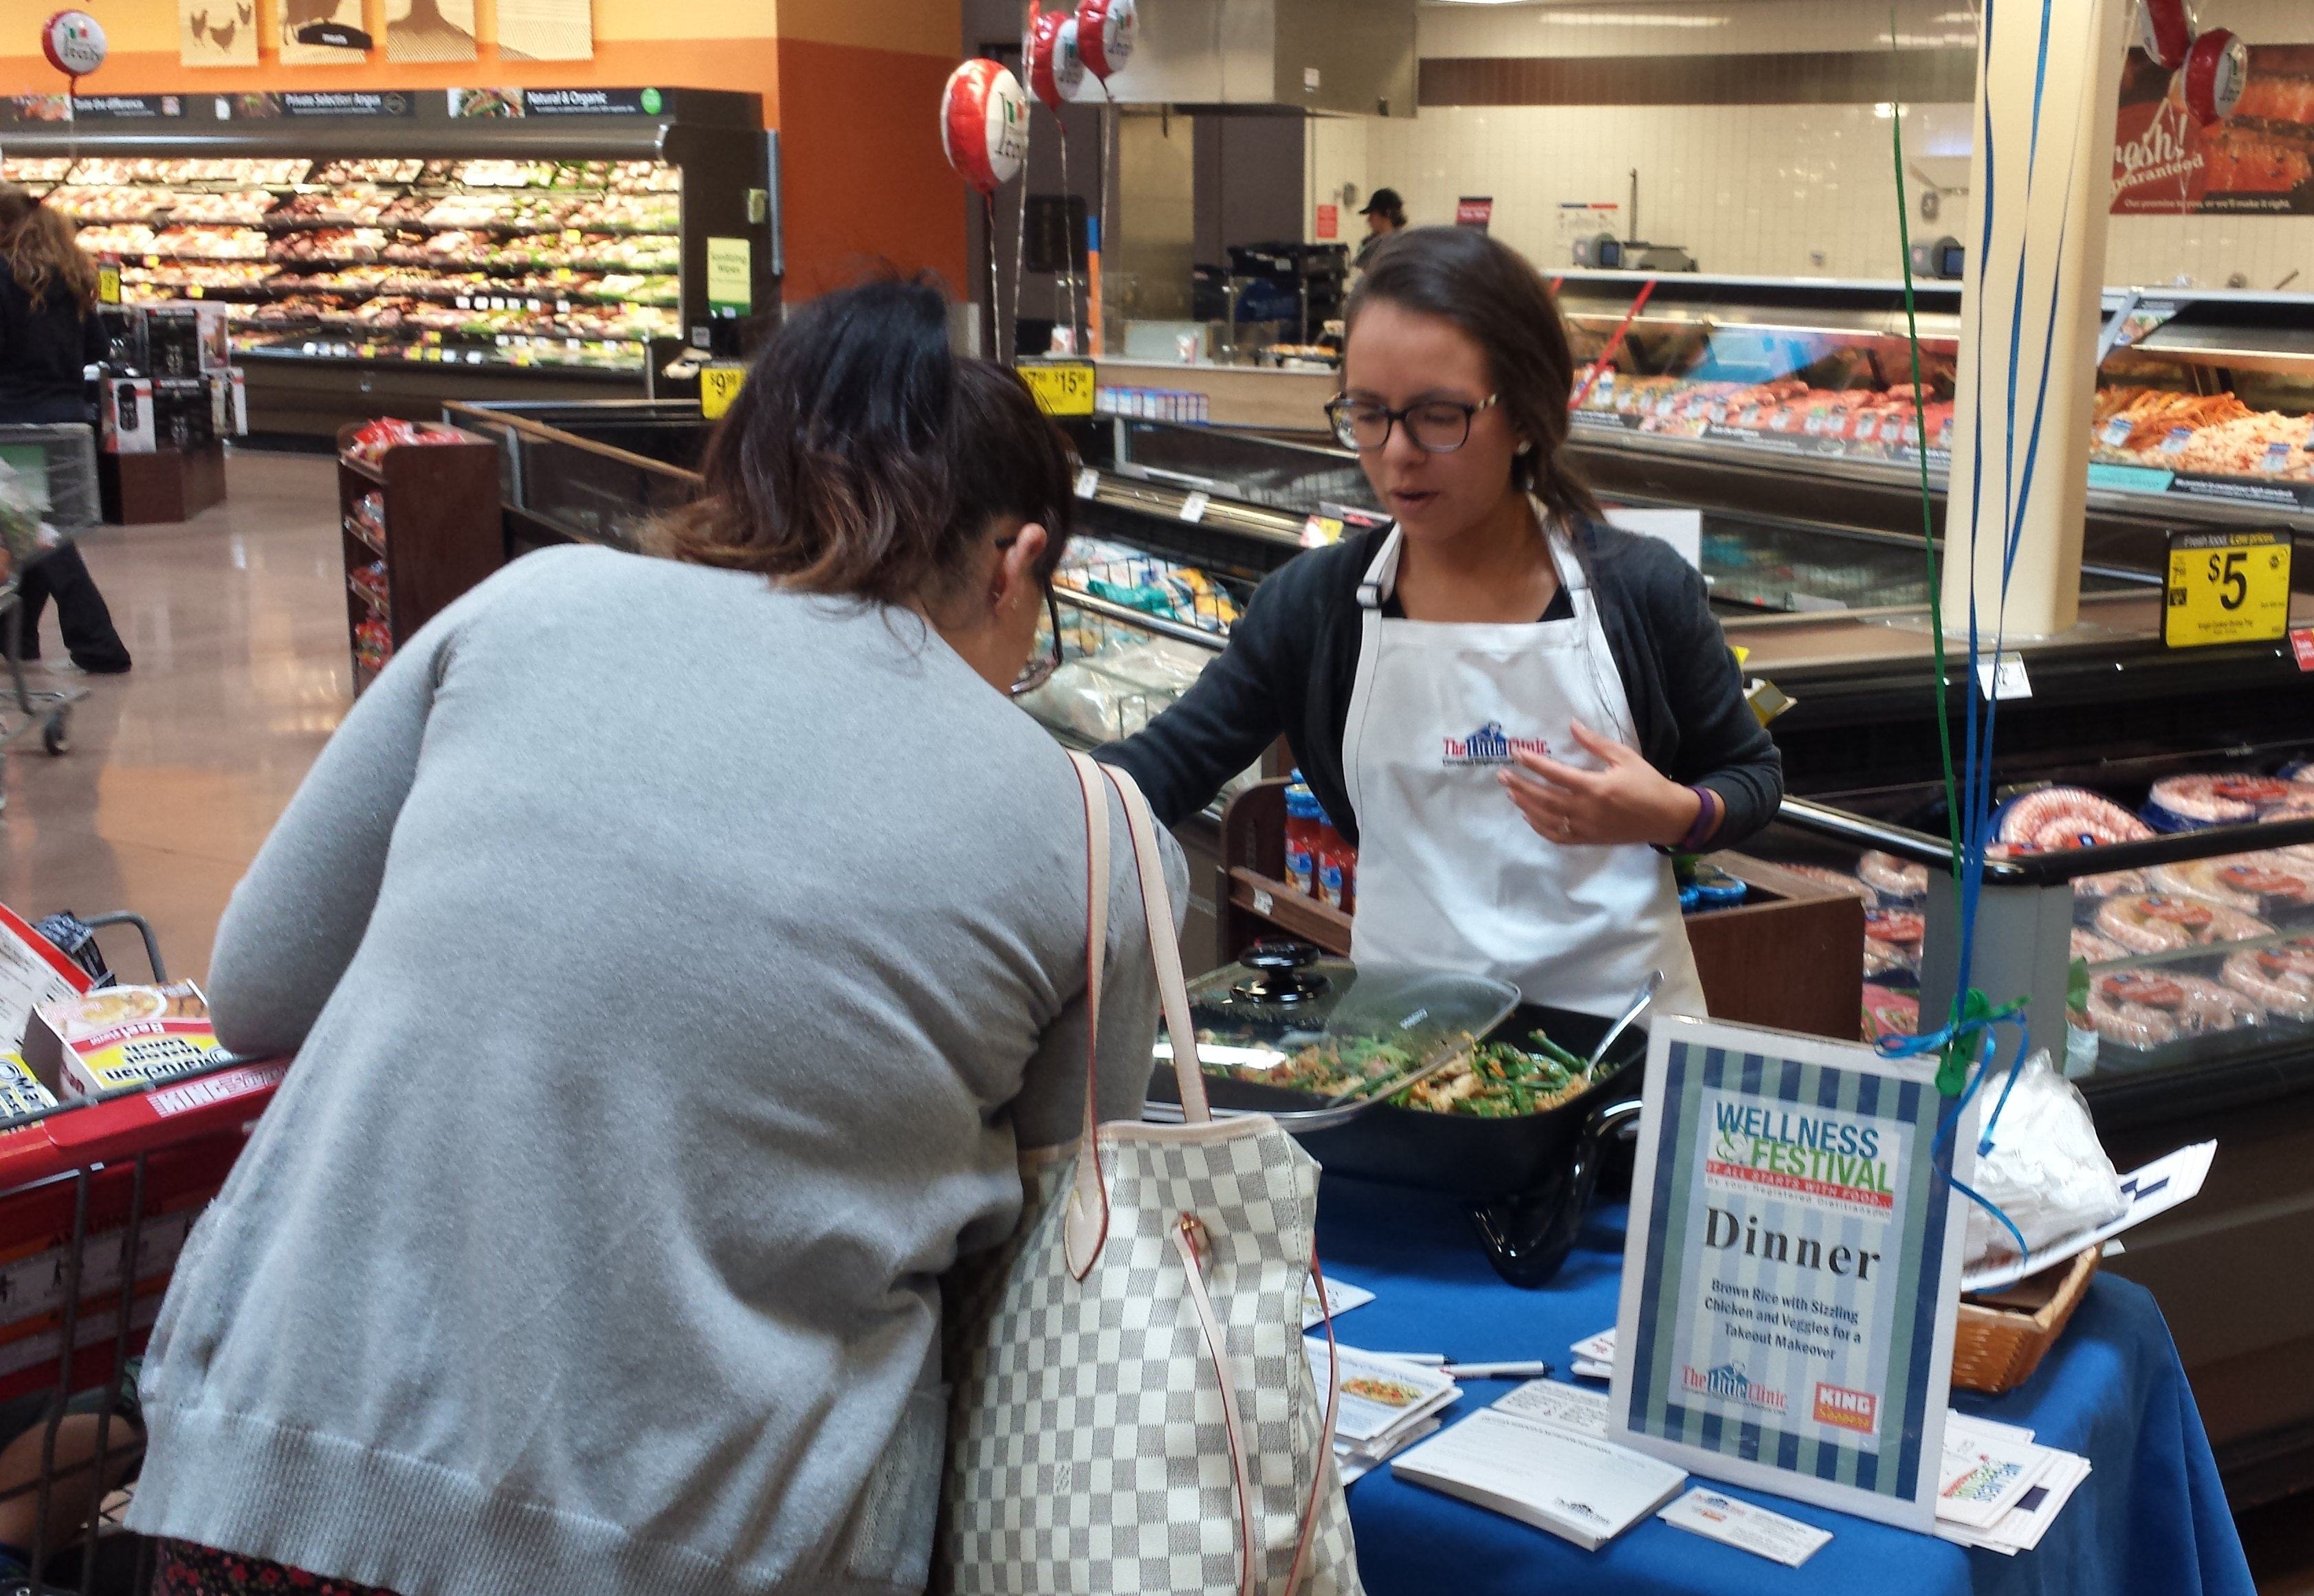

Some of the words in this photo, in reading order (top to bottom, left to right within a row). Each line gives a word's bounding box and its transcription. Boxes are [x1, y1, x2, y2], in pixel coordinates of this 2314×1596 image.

[2207, 552, 2248, 610] $5
[1444, 738, 1465, 755] The
[1466, 735, 1508, 757] Little
[120, 1022, 165, 1039] Beef
[157, 1079, 230, 1114] KING
[1716, 1101, 1880, 1160] WELLNESS
[1707, 1161, 1719, 1174] IT
[1723, 1164, 1745, 1179] ALL
[1751, 1170, 1800, 1189] STARTS
[1805, 1180, 1838, 1196] WITH
[1750, 1140, 1894, 1193] FESTIVAL
[1708, 1176, 1718, 1186] By
[1753, 1184, 1811, 1204] Registered
[1705, 1206, 1881, 1281] Dinner
[1705, 1296, 1753, 1320] Chicken
[1756, 1311, 1779, 1325] and
[1782, 1314, 1829, 1337] Veggies
[1833, 1325, 1851, 1341] for
[1853, 1332, 1862, 1344] a
[1711, 1278, 1749, 1299] Brown
[1752, 1287, 1778, 1304] Rice
[1782, 1296, 1808, 1311] with
[1811, 1301, 1859, 1325] Sizzling
[1724, 1321, 1772, 1346] Takeout
[1775, 1335, 1836, 1360] Makeover
[1682, 1364, 1706, 1389] The
[1707, 1371, 1747, 1399] Little
[1747, 1382, 1787, 1408] Clinic
[1820, 1386, 1870, 1415] KING
